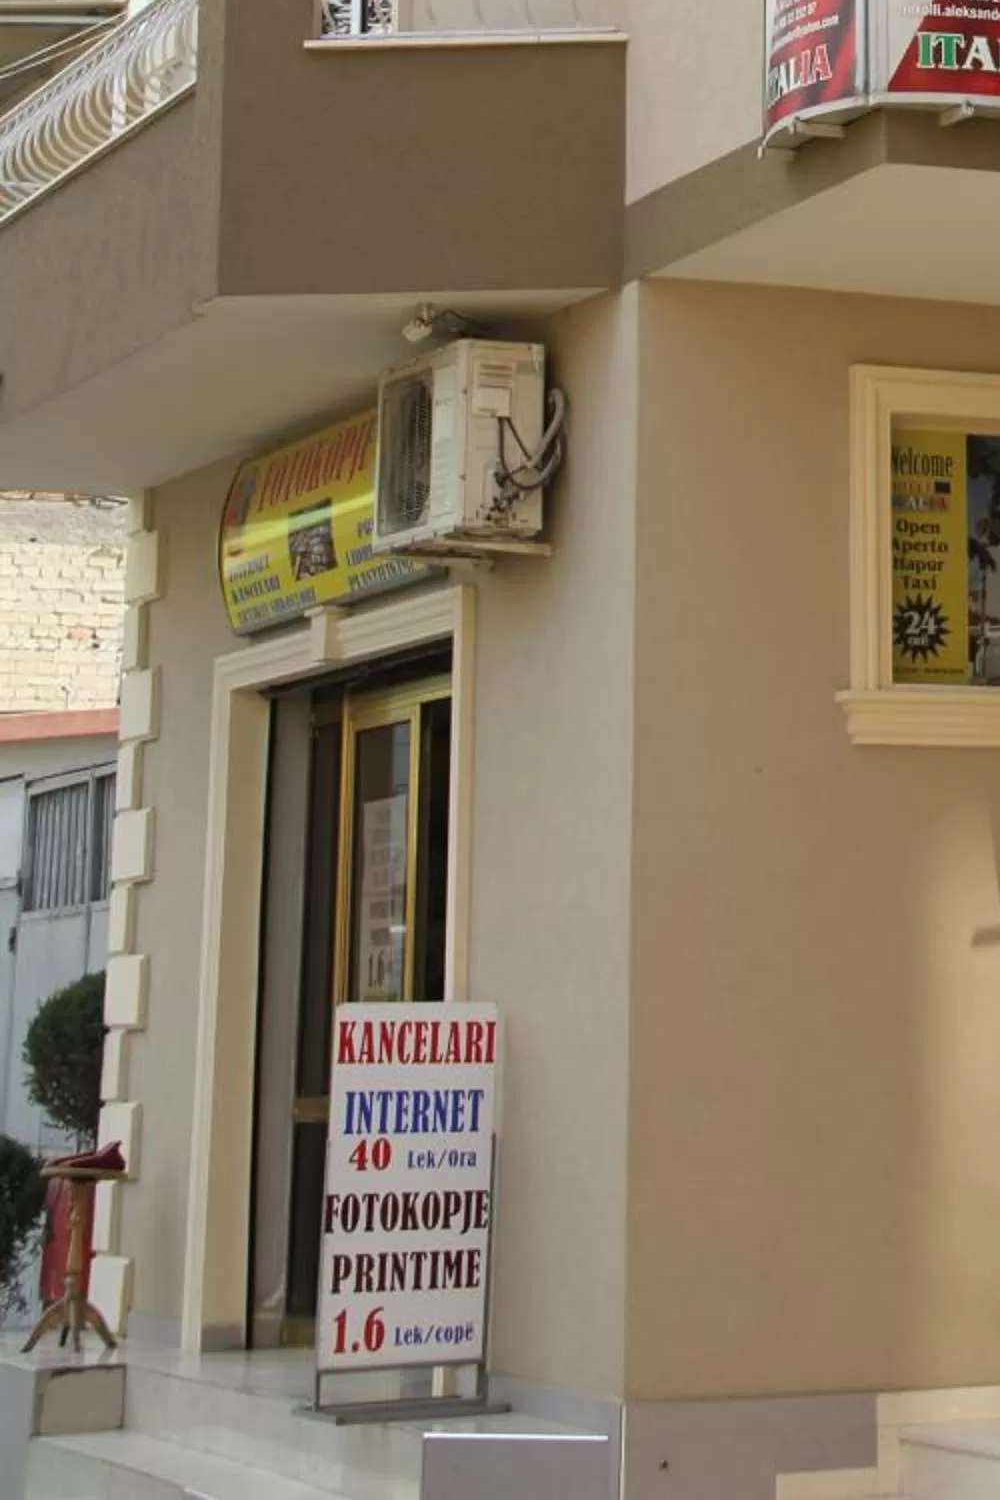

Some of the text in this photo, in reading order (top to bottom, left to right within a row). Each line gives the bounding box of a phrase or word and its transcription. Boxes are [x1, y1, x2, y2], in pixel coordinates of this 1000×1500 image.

[896, 518, 941, 536] Open
[900, 575, 938, 590] Taxi
[904, 611, 938, 635] 24
[337, 1021, 497, 1065] KANCELARI
[343, 1088, 484, 1135] INTERNET
[348, 1137, 478, 1172] 40 Lek/Ora
[324, 1189, 489, 1235] FOTOKOPJE
[331, 1248, 481, 1295] PRINTIME
[333, 1306, 385, 1355] 1.6
